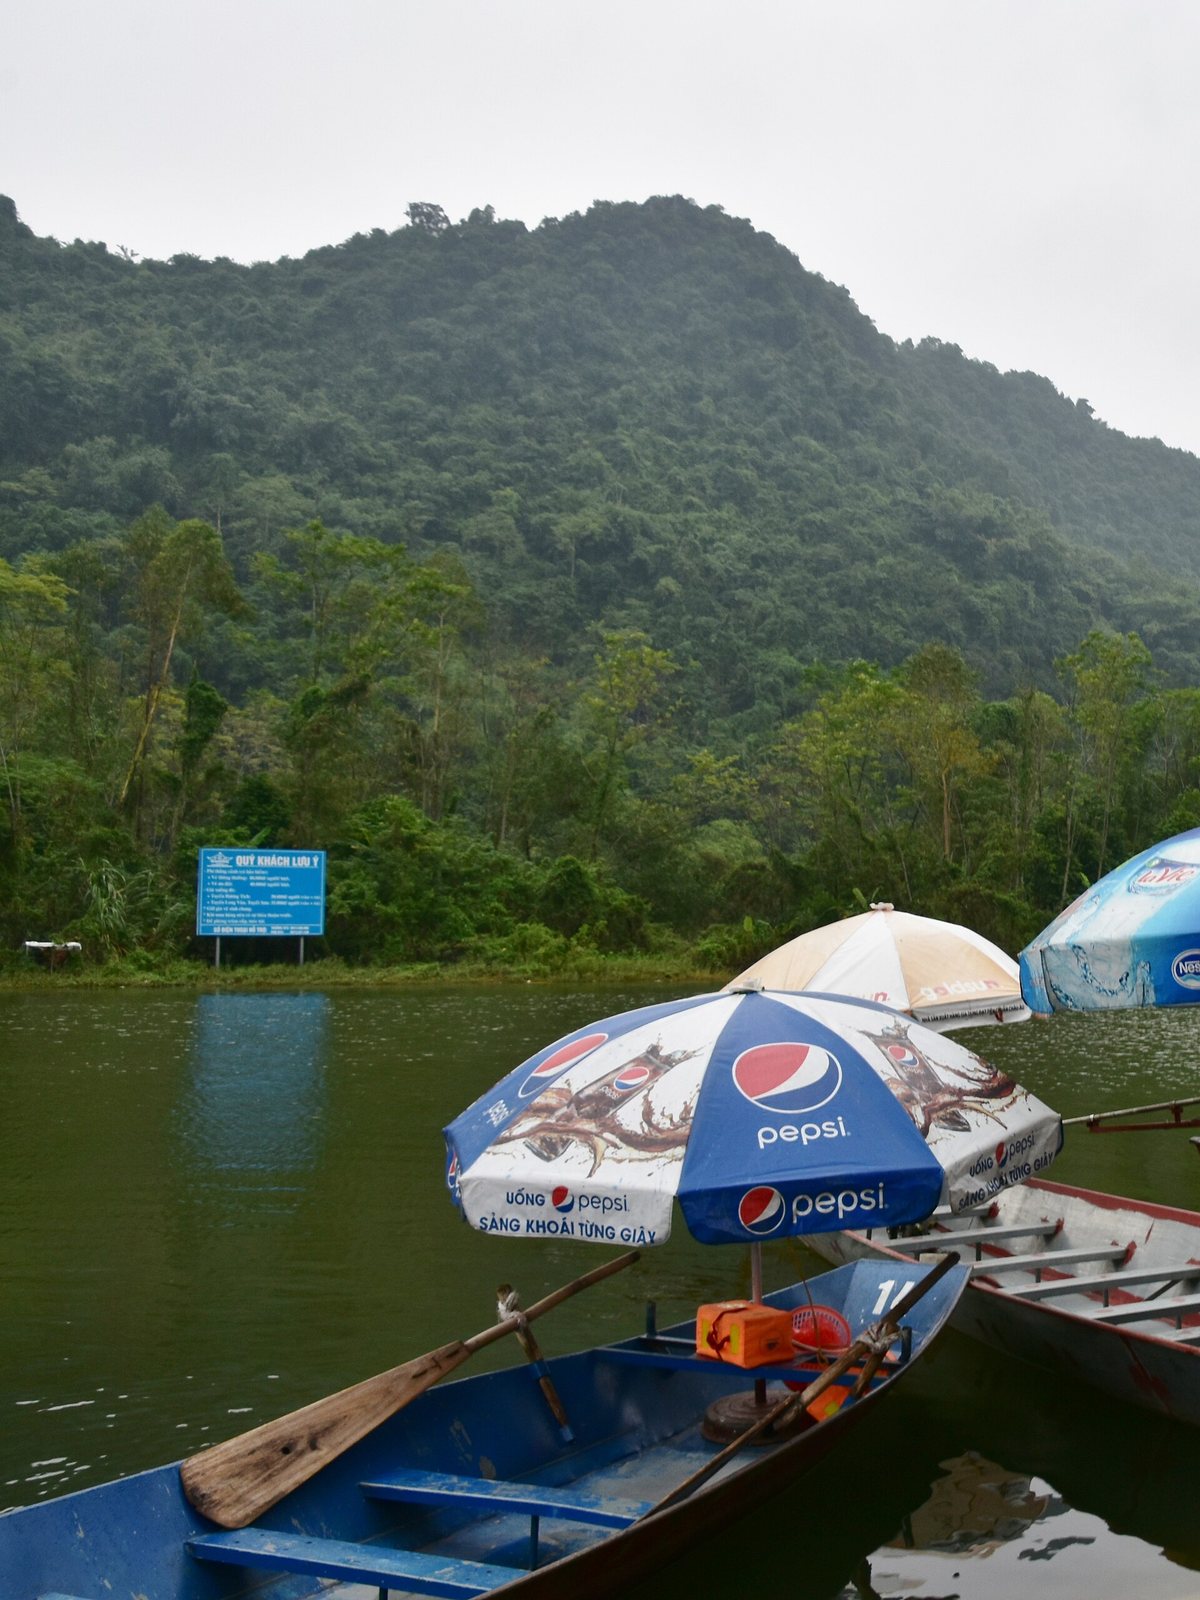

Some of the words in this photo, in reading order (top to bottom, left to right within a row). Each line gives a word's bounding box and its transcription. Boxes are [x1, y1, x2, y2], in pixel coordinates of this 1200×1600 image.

[258, 854, 290, 867] KHÁCH
[920, 980, 1000, 1001] goldsun
[757, 1116, 851, 1149] pepsi
[970, 1154, 994, 1177] UỐNG
[1009, 1131, 1035, 1161] pepsi
[506, 1187, 545, 1206] UỐNG
[578, 1194, 630, 1214] pepsi
[791, 1182, 888, 1223] pepsi
[479, 1212, 521, 1232] SẢNG
[526, 1217, 575, 1235] KHOÁI
[578, 1220, 615, 1240] TỪNG
[620, 1226, 656, 1245] GIÂY
